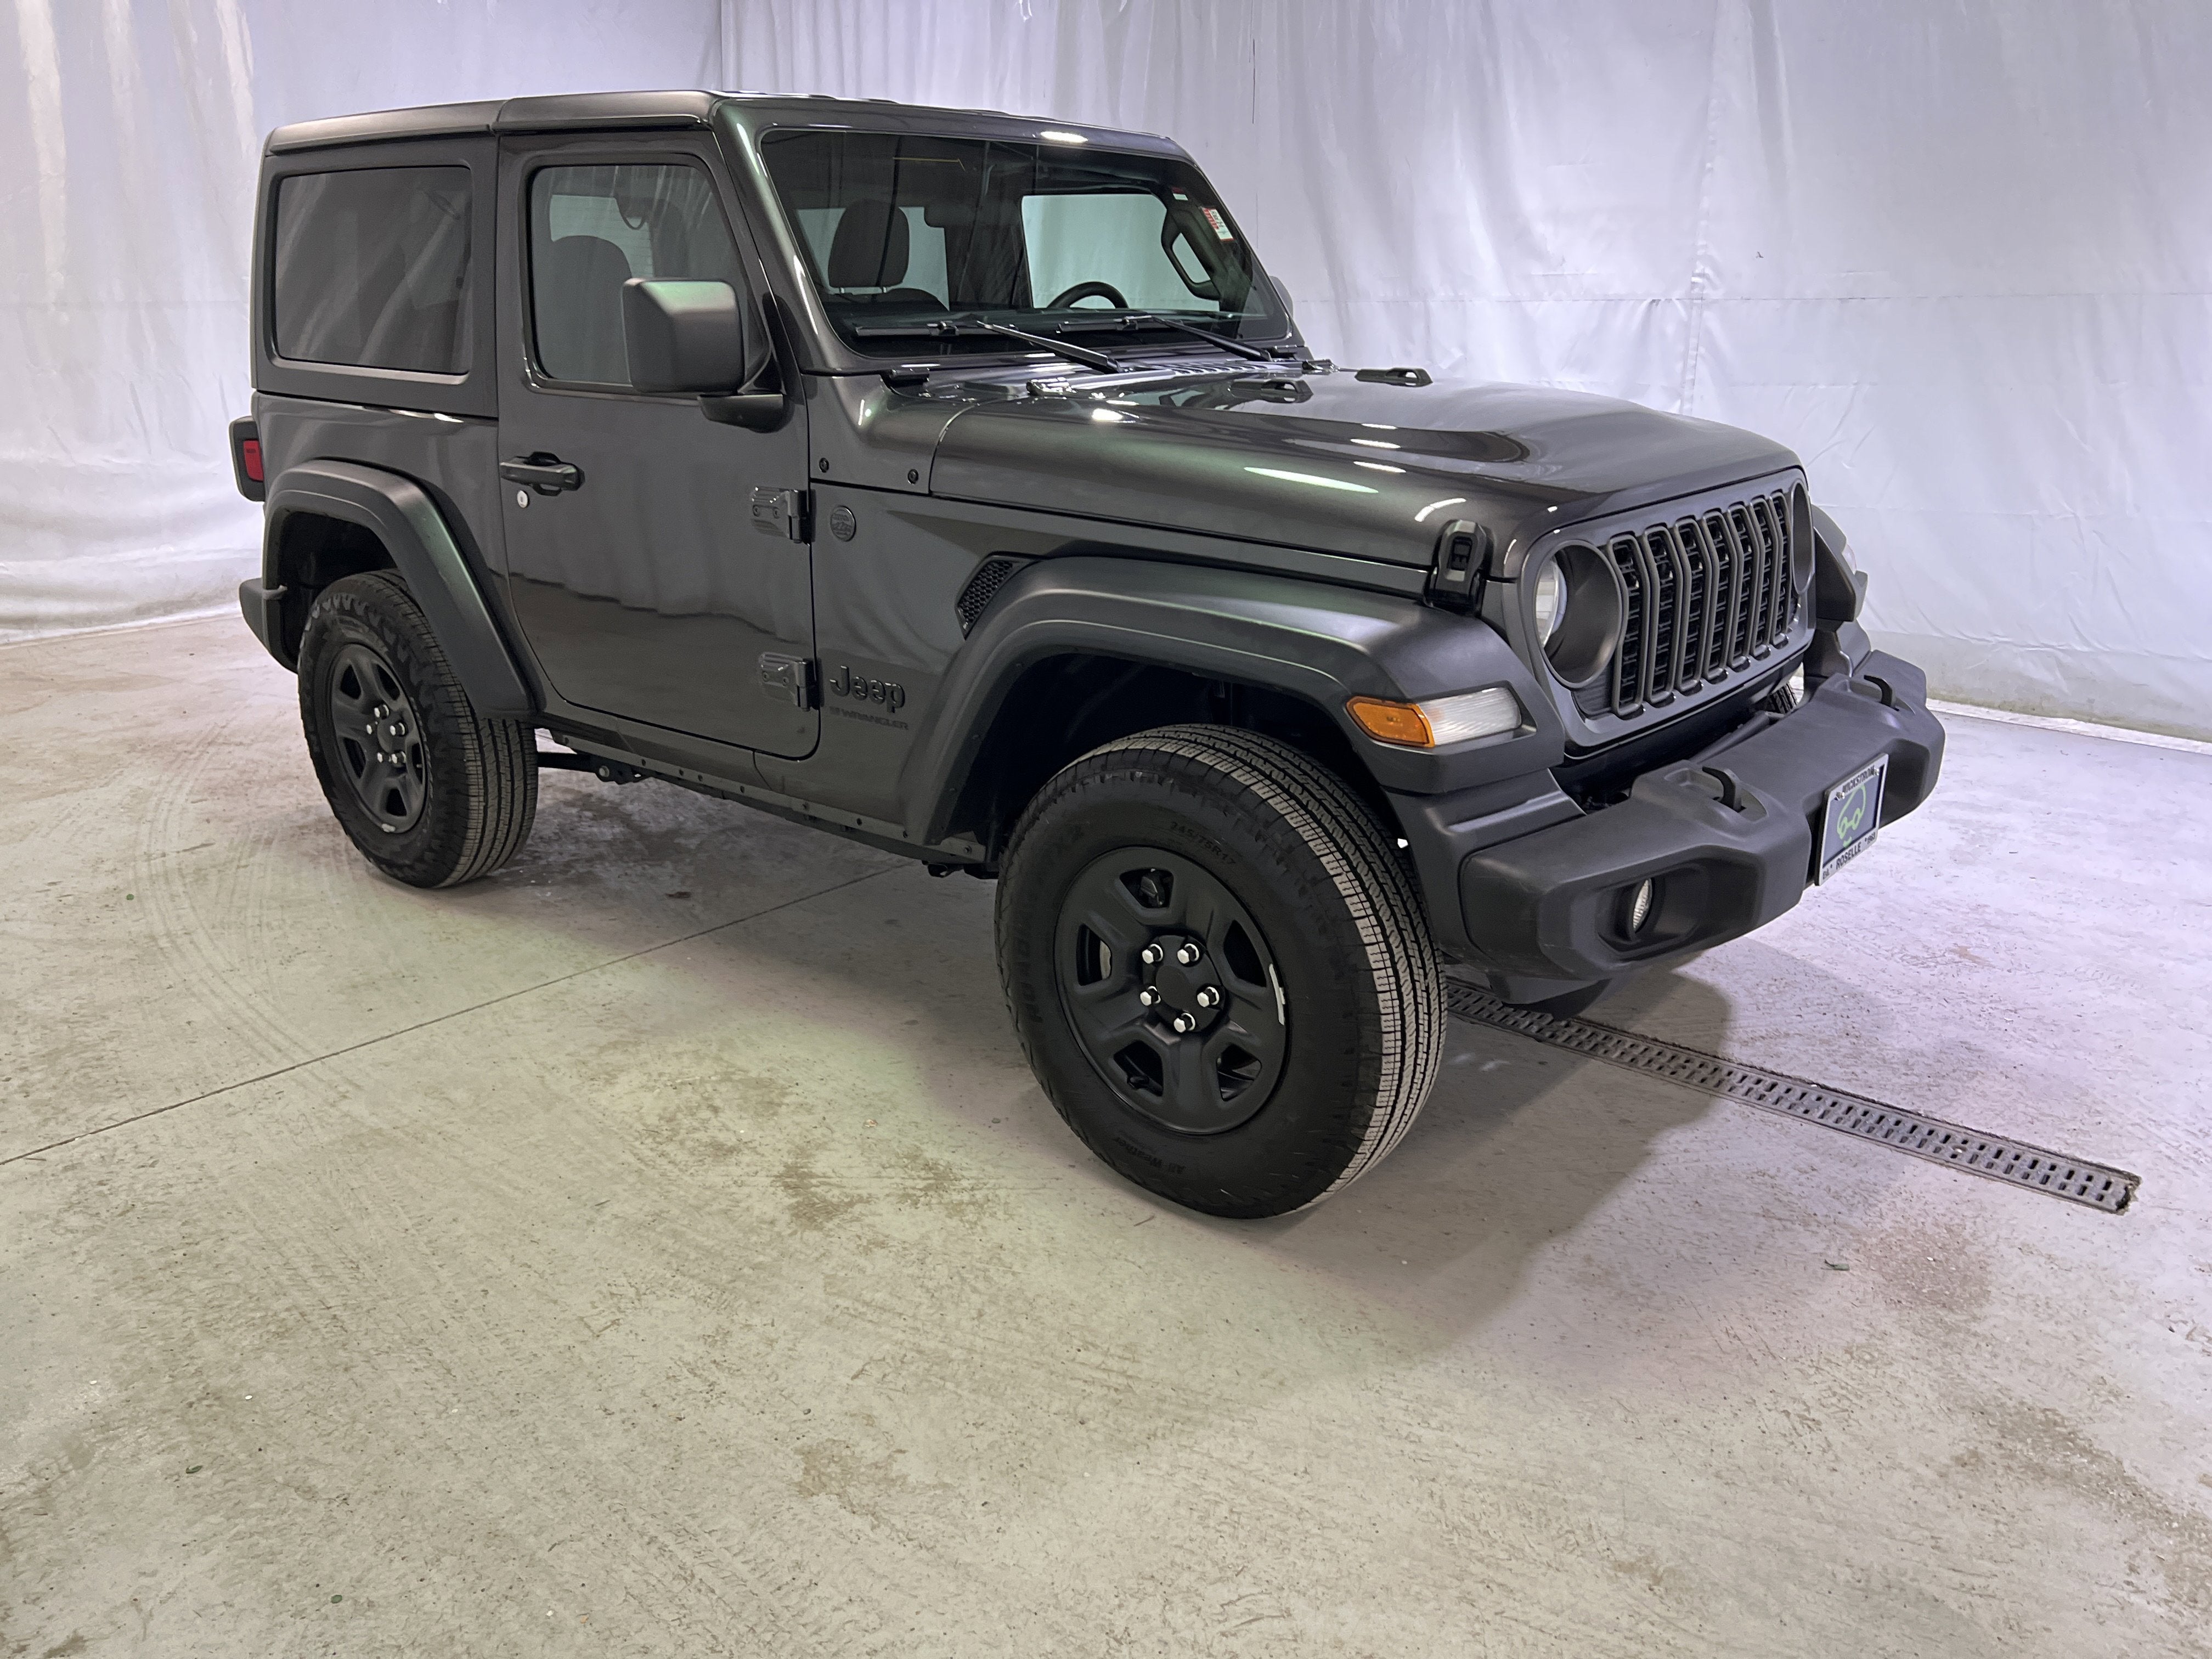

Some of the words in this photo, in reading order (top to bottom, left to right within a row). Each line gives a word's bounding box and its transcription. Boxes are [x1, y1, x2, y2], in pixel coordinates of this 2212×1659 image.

[829, 665, 906, 714] Jeep
[1170, 821, 1237, 865] 245/75R17
[1836, 841, 1861, 870] ROSELLE
[1112, 1137, 1163, 1169] Weather
